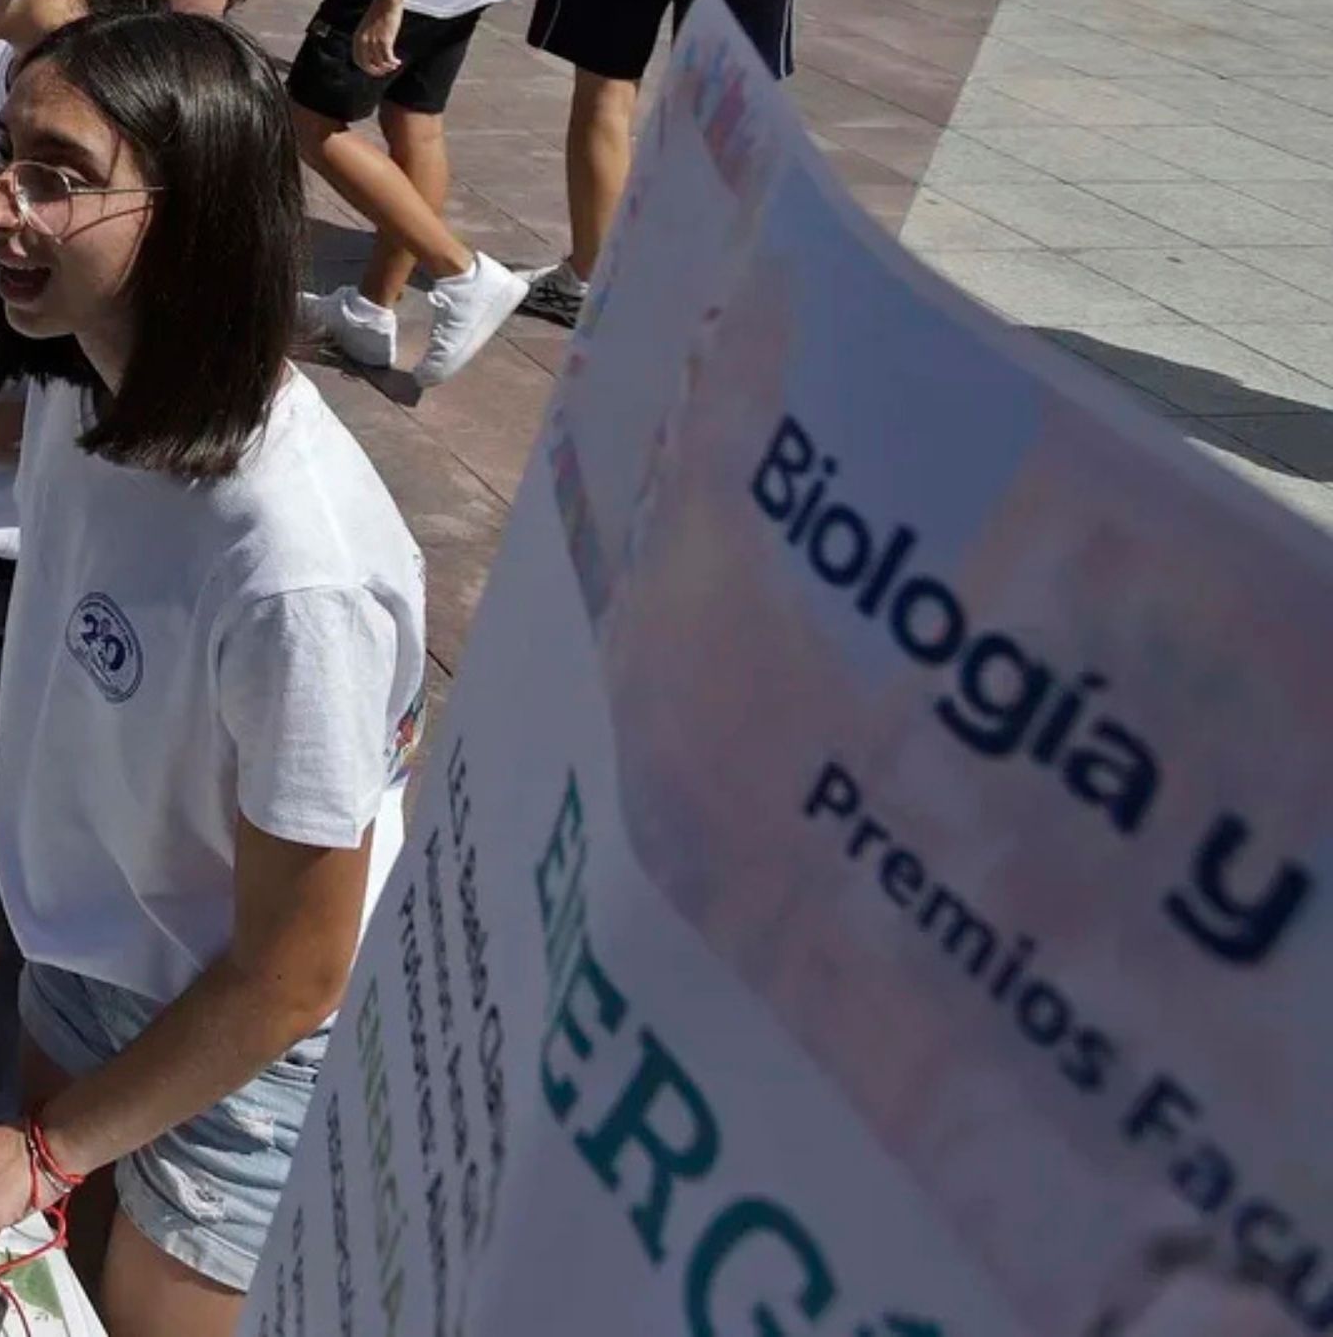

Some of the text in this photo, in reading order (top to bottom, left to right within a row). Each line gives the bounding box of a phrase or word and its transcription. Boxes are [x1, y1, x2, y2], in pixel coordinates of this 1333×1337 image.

[747, 413, 1315, 968] Biología y
[803, 760, 1120, 1096] Premios
